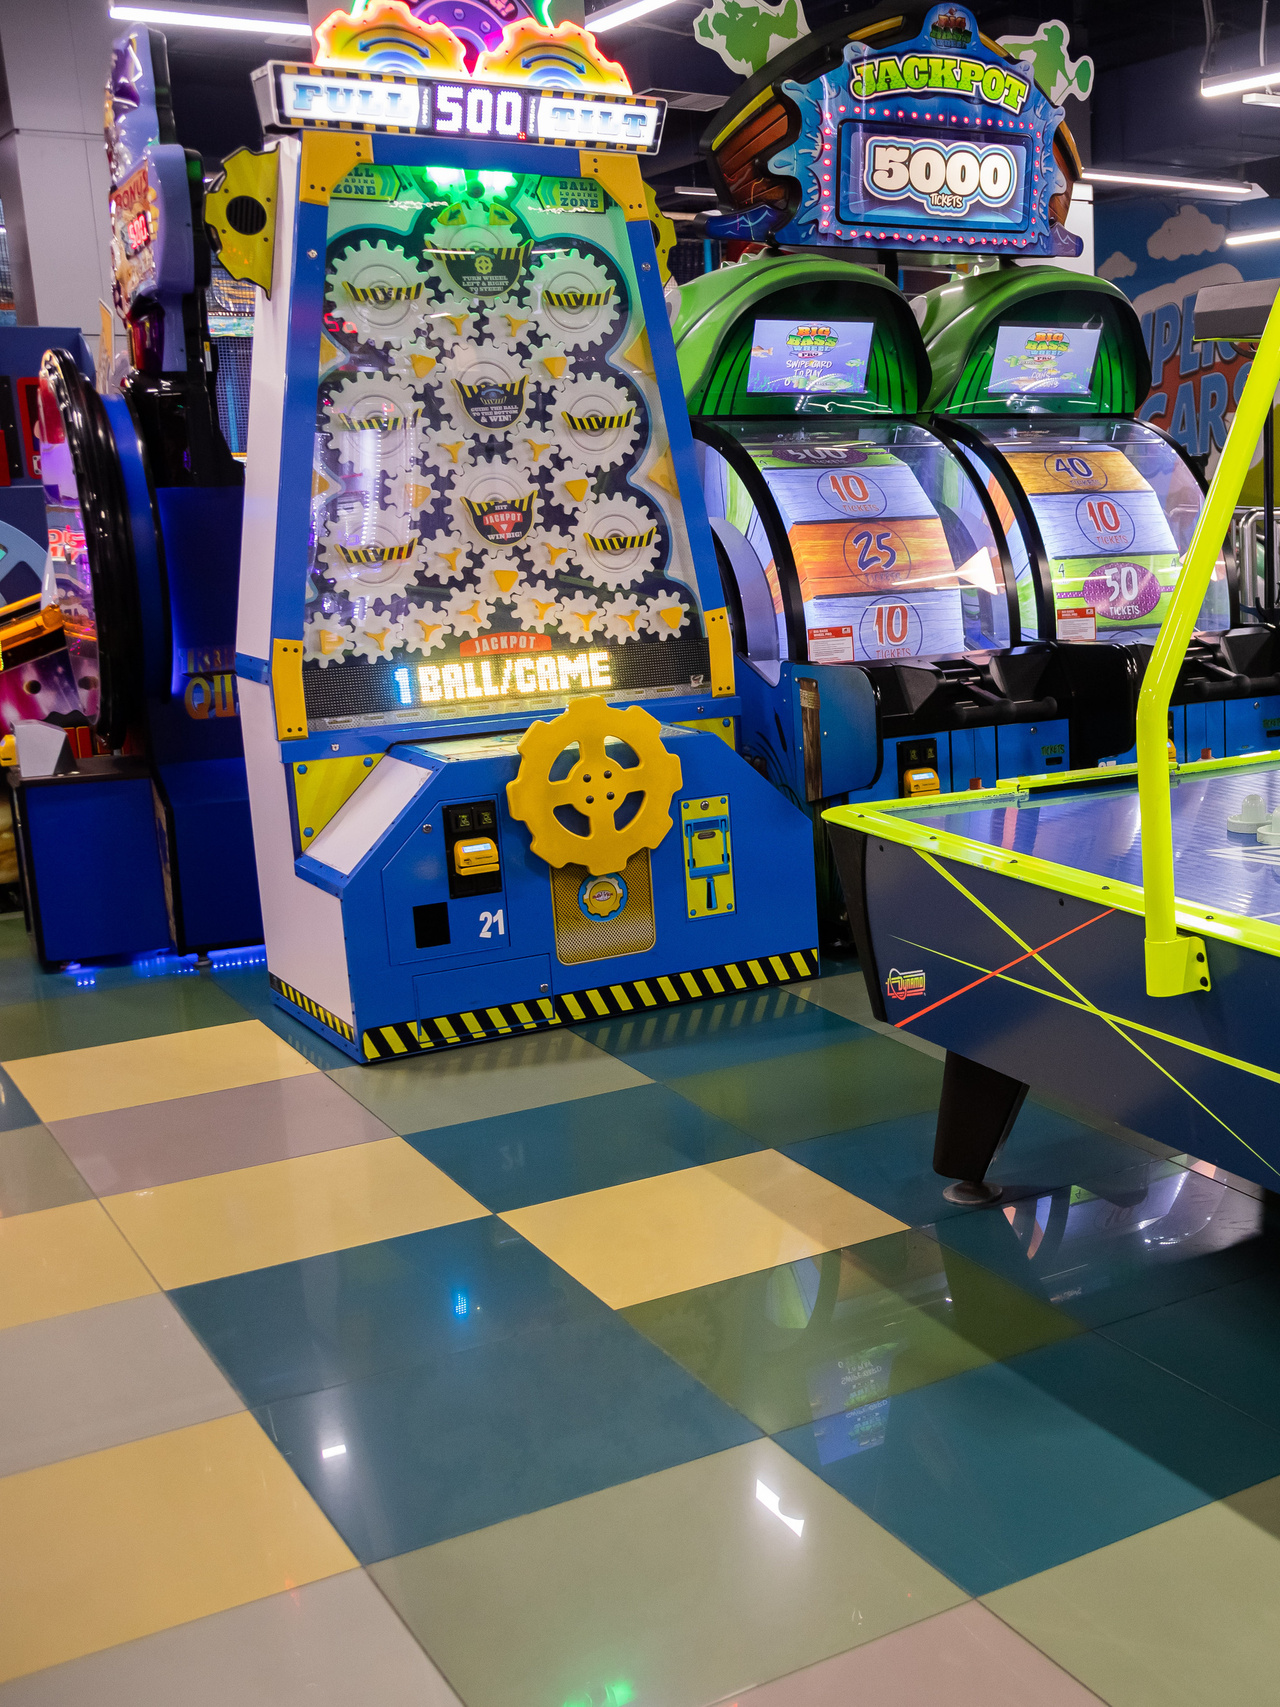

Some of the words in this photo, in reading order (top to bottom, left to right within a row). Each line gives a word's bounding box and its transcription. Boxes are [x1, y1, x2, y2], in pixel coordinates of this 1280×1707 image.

[853, 56, 1028, 109] JACKPOT
[293, 82, 411, 118] FULL
[436, 84, 523, 135] 500
[551, 106, 649, 139] TILT
[872, 145, 1011, 198] 5000
[115, 169, 148, 209] BONUS
[332, 184, 376, 196] ZONE
[559, 181, 598, 192] BALL
[560, 197, 599, 208] ZONE
[930, 193, 963, 208] TICKETS
[797, 326, 831, 337] BIG
[1034, 331, 1065, 342] BIG
[786, 334, 839, 348] BASS
[1024, 340, 1070, 352] BASS
[786, 359, 810, 369] SWIPE
[805, 368, 823, 377] PLAY
[489, 415, 512, 423] WIN!
[1054, 457, 1094, 479] 40
[830, 475, 870, 503] 10
[843, 504, 879, 512] TICKETS
[485, 513, 521, 525] JACKPOT
[1085, 500, 1121, 534] 10
[1096, 535, 1128, 545] TICKETS
[852, 531, 897, 571] 25
[1058, 563, 1065, 578] 4
[1104, 566, 1140, 602] 50
[1109, 605, 1140, 616] TICKETS
[873, 605, 909, 646] 10
[475, 636, 536, 653] JACKPOT
[394, 667, 412, 705] 1
[417, 651, 612, 702] BALL/GAME
[1040, 744, 1065, 756] TICKETS
[479, 909, 505, 938] 21
